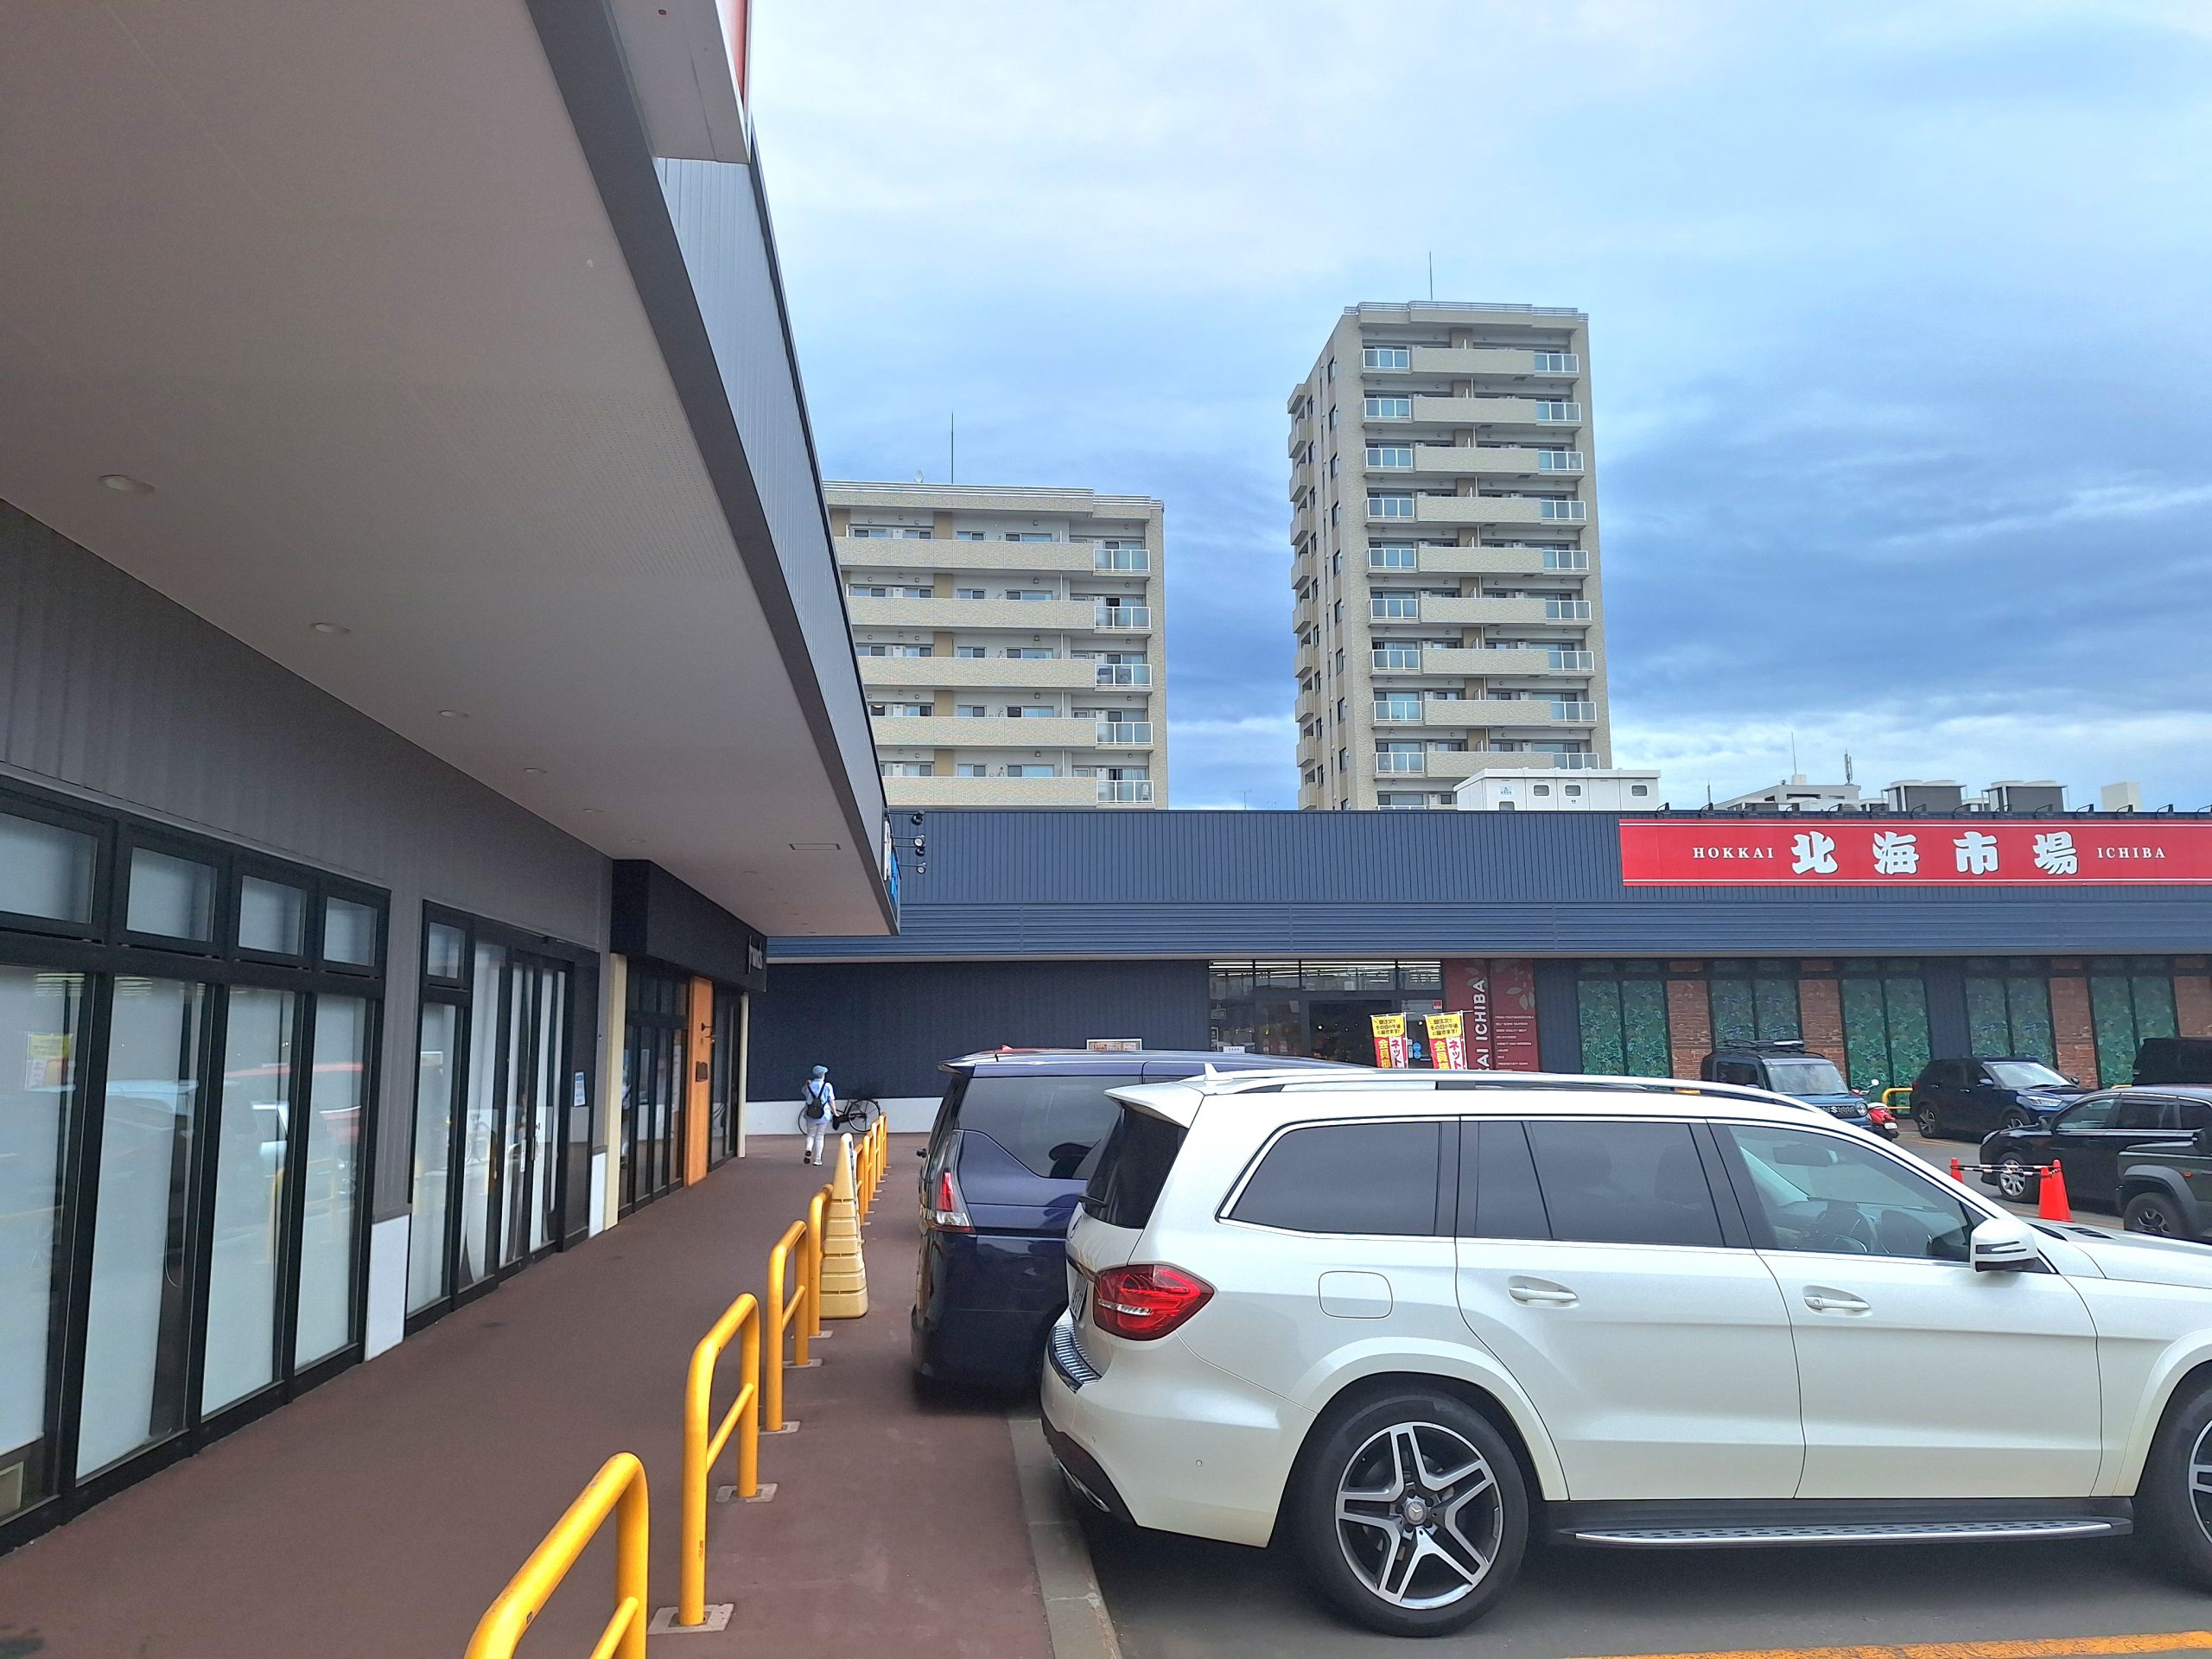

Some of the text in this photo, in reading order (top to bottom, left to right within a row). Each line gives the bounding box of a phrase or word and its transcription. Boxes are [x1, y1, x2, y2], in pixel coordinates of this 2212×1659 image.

[1693, 847, 1774, 859] HOKKAI
[1790, 830, 2079, 875] 北海市場
[2096, 847, 2166, 859] ICHIBA
[1473, 980, 1490, 1070] AI ICHIBA
